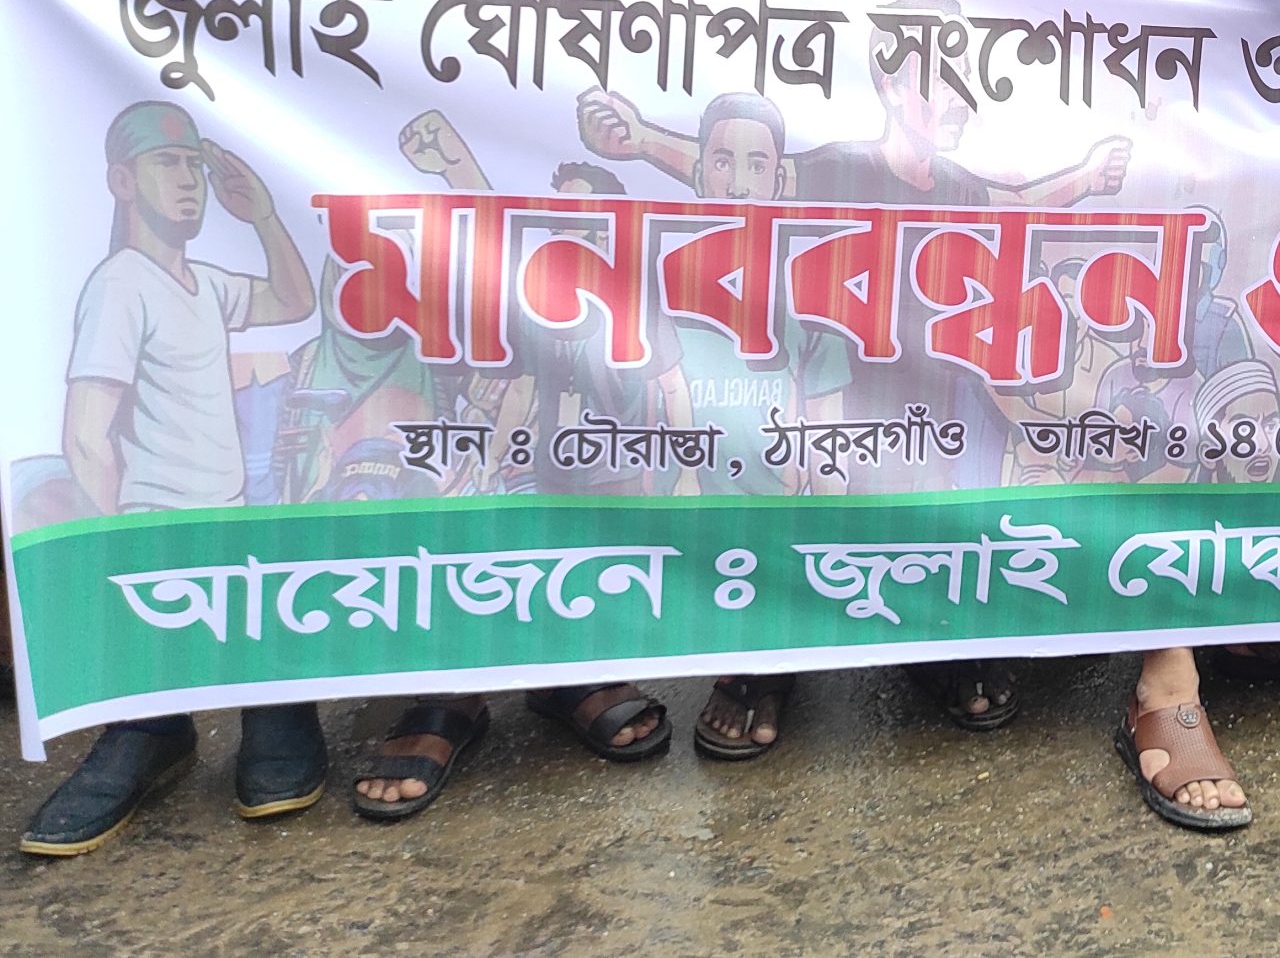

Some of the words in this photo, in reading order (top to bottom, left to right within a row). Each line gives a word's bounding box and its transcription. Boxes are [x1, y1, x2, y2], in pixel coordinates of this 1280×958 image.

[867, 9, 1216, 112] সংশোধন
[311, 193, 1208, 385] মানববন্ধন
[394, 421, 495, 477] স্থান
[762, 404, 966, 478] ঠাকুরগাঁও
[1020, 412, 1155, 460] তারিখ
[1205, 419, 1257, 461] ১৪
[108, 544, 683, 643] আয়োজনে
[791, 514, 1081, 627] জুলাই
